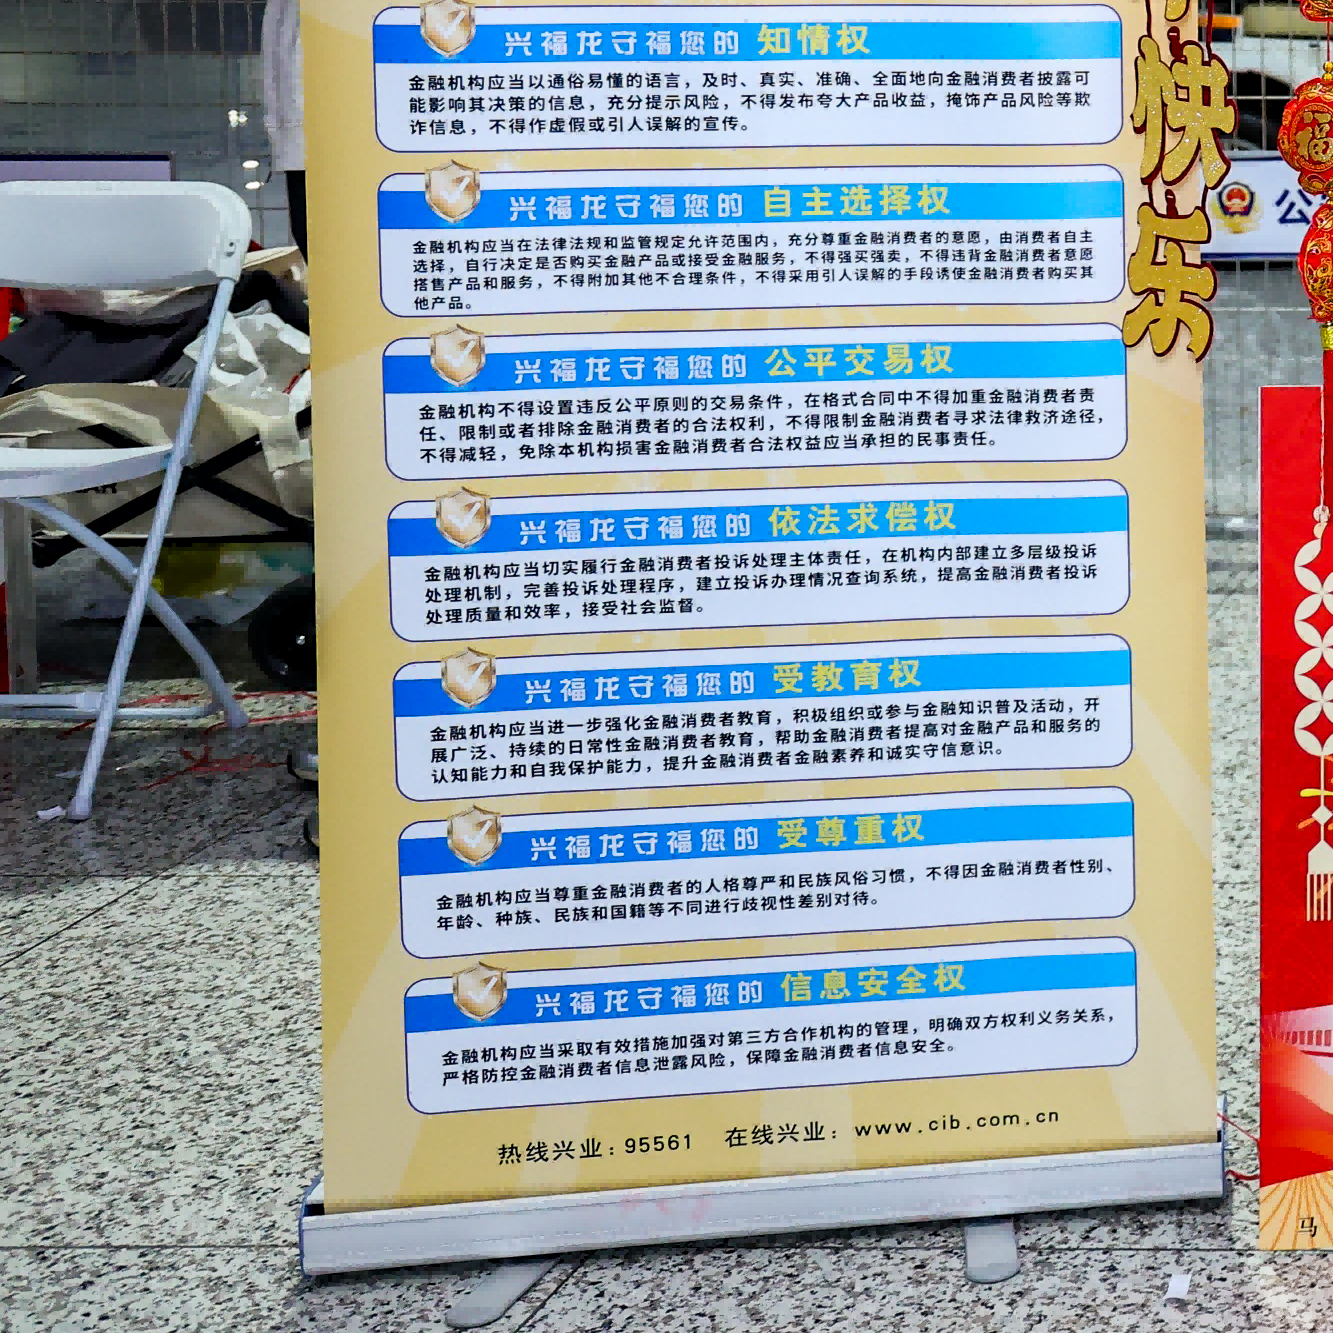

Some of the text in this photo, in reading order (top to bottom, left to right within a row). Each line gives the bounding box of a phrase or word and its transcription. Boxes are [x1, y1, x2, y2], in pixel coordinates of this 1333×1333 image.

[505, 24, 871, 58] 兴福龙守福您的 知情权
[408, 70, 1090, 91] 金融机构应当以通俗易懂的语言，及时、真实、准确、全面地向金融消费者披露可
[409, 92, 1091, 113] 能影响其决策的信息，充分提示风险，不得发布夸大产品收益，掩饰产品风险等欺
[410, 116, 748, 136] 诈信息，不得作虚假或引人误解的宣传。
[509, 184, 951, 222] 兴福龙守福您的 自主选择权
[412, 230, 1094, 255] 金融机构应当在法律法规和监管规定允许范围内，充分尊重金融消费者的意愿，由消费者自主
[412, 247, 1094, 274] 选择，自行决定是否购买金融产品或接受金融服务，不得强买强卖，不得违背金融消费者意愿
[413, 265, 1094, 292] 搭售产品和服务，不得附加其他不合理条件，不得采用引人误解的手段诱使金融消费者购买其
[414, 295, 473, 311] 他产品。
[514, 343, 954, 384] 兴福龙守福您的 公平交易权
[418, 388, 1095, 421] 金融机构不得设置违反公平原则的交易条件，在格式合同中不得加重金融消费者责
[419, 409, 1104, 442] 任、限制或者排除金融消费者的合法权利，不得限制金融消费者寻求法律救济途径，
[420, 431, 997, 464] 不得减轻，免除本机构损害金融消费者合法权益应当承担的民事责任。
[520, 501, 957, 546] 兴福龙守福您的 依法求偿权
[424, 543, 1098, 583] 金融机构应当切实履行金融消费者投诉处理主体责任，在机构内部建立多层级投诉
[424, 565, 1098, 603] 处理机制，完善投诉处理程序，建立投诉办理情况查询系统，提高金融消费者投诉
[425, 597, 706, 626] 处理质量和效率，接受社会监督。
[525, 658, 922, 704] 兴福龙守福您的 受教育权
[429, 697, 1100, 743] 金融机构应当进一步强化金融消费者教育，积极组织或参与金融知识普及活动，开
[430, 717, 1101, 764] 展广泛、持续的日常性金融消费者教育，帮助金融消费者提高对金融产品和服务的
[431, 740, 1005, 785] 认知能力和自我保护能力，提升金融消费者金融素养和诚实守信意识。
[530, 813, 925, 862] 兴福龙守福您的 受尊重权
[436, 859, 1114, 911] 金融机构应当尊重金融消费者的人格尊严和民族风俗习惯，不得因金融消费者性别、
[437, 891, 880, 932] 年龄、种族、民族和国籍等不同进行歧视性差别对待。
[535, 964, 966, 1018] 兴福龙守福您的 信息安全权
[441, 1008, 1115, 1066] 金融机构应当采取有效措施加强对第三方合作机构的管理，明确双方权利义务关系，
[442, 1037, 955, 1087] 严格防控金融消费者信息泄露风险，保障金融消费者信息安全。
